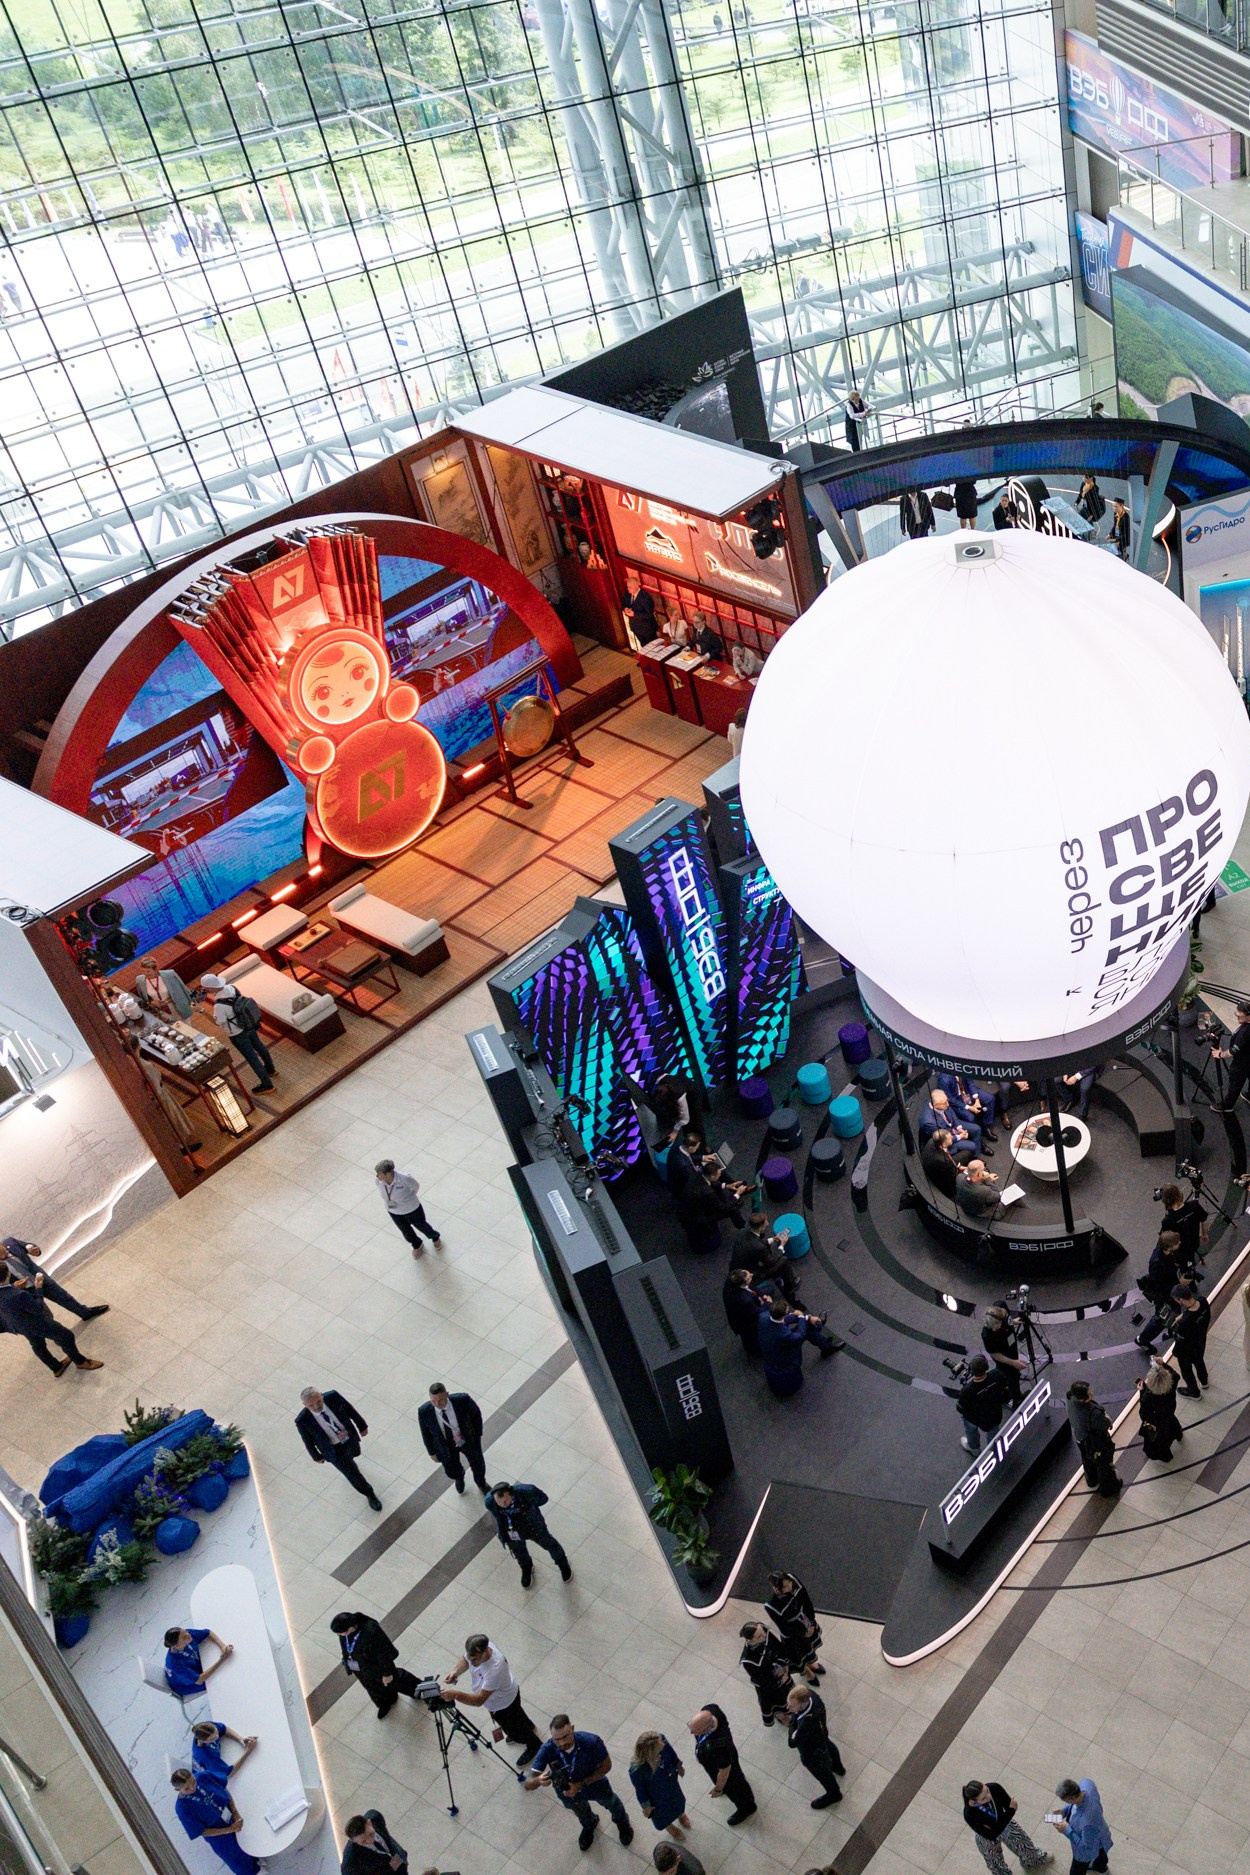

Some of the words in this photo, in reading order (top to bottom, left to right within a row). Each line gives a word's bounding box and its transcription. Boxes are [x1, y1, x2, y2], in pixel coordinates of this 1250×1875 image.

[1203, 516, 1246, 536] РусГидро
[1098, 769, 1219, 869] ПРО
[1108, 808, 1223, 905] СВЕ
[1060, 838, 1102, 954] через
[1110, 861, 1209, 941] ЩЕ
[894, 1037, 926, 1061] СИЛА
[927, 1055, 1023, 1078] ИНВЕСТИЦИЙ
